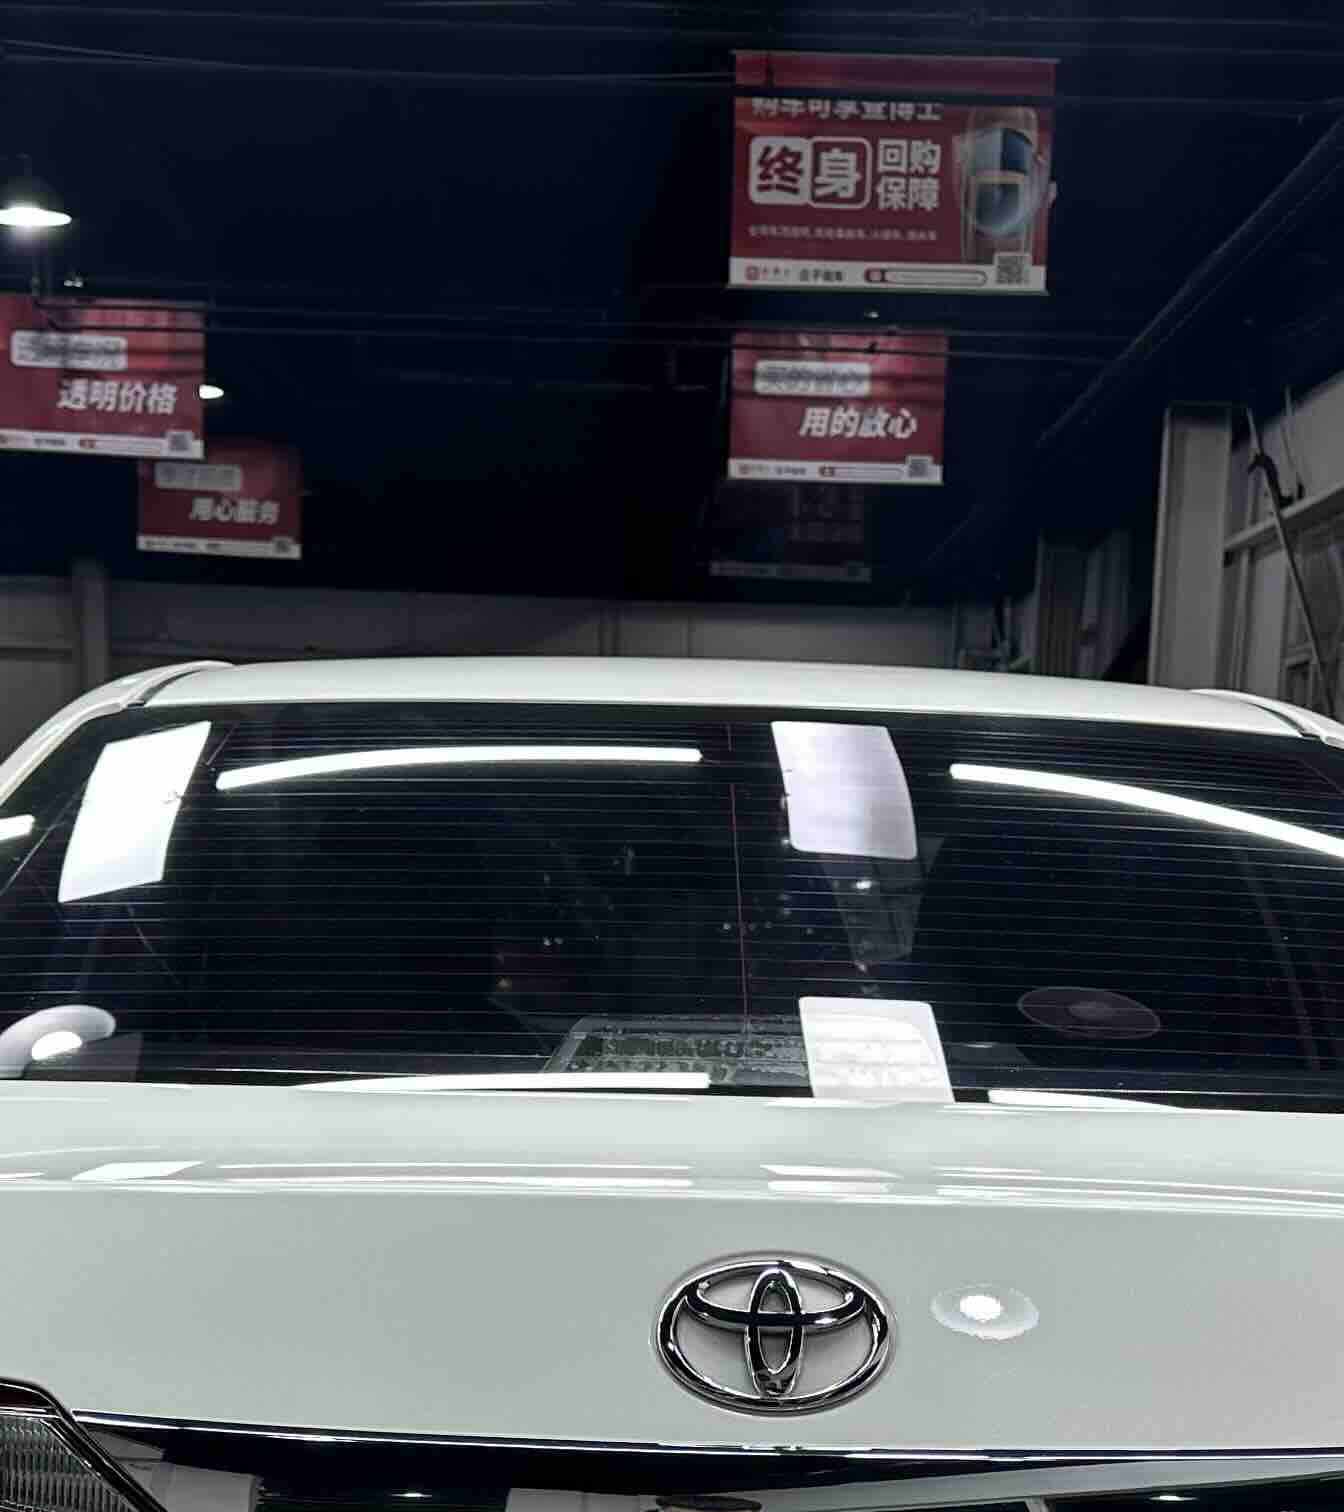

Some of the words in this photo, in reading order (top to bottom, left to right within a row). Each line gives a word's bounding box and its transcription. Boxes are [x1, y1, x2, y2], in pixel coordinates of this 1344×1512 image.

[756, 146, 861, 199] 终身
[877, 138, 942, 175] 回购
[875, 176, 940, 211] 保障
[58, 378, 178, 415] 透明价格
[799, 405, 918, 438] 用的放心
